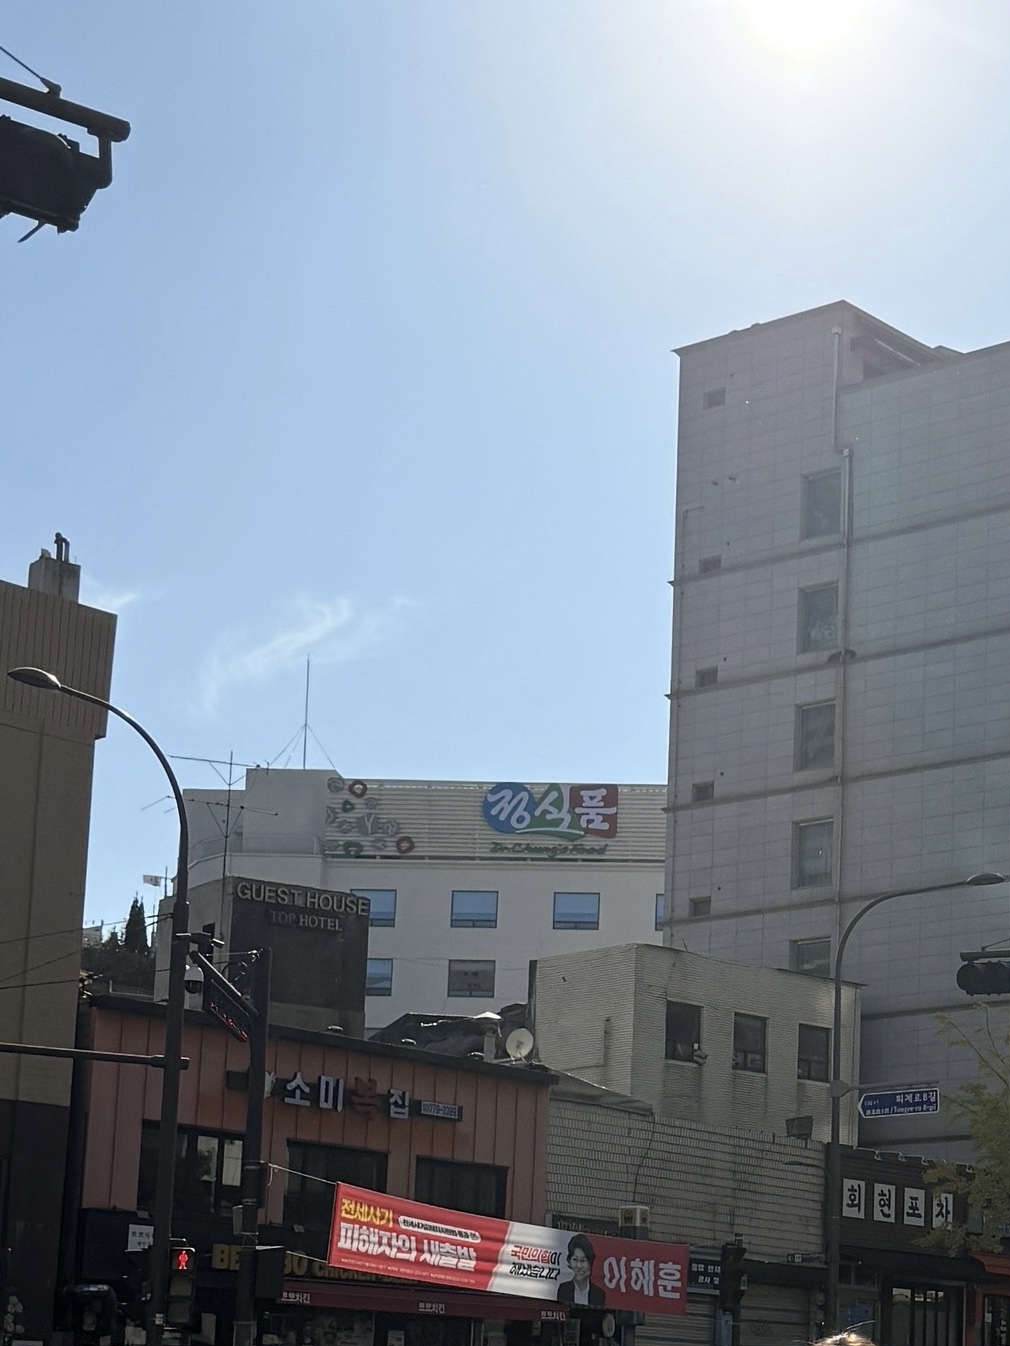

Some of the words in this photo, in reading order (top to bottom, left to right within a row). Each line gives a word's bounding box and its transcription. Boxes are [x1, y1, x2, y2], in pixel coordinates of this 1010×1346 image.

[486, 783, 618, 831] 정식품
[237, 882, 302, 907] GUEST
[306, 891, 369, 916] HOUSE
[271, 911, 296, 925] TOP
[299, 914, 342, 931] HOTEL
[341, 1198, 393, 1228] 전세사기
[847, 1183, 951, 1222] 회현포차
[338, 1222, 418, 1262] 피해자의
[420, 1238, 477, 1271] 새출발
[511, 1245, 562, 1266] 국민의힘이
[603, 1255, 682, 1300] 이혜훈
